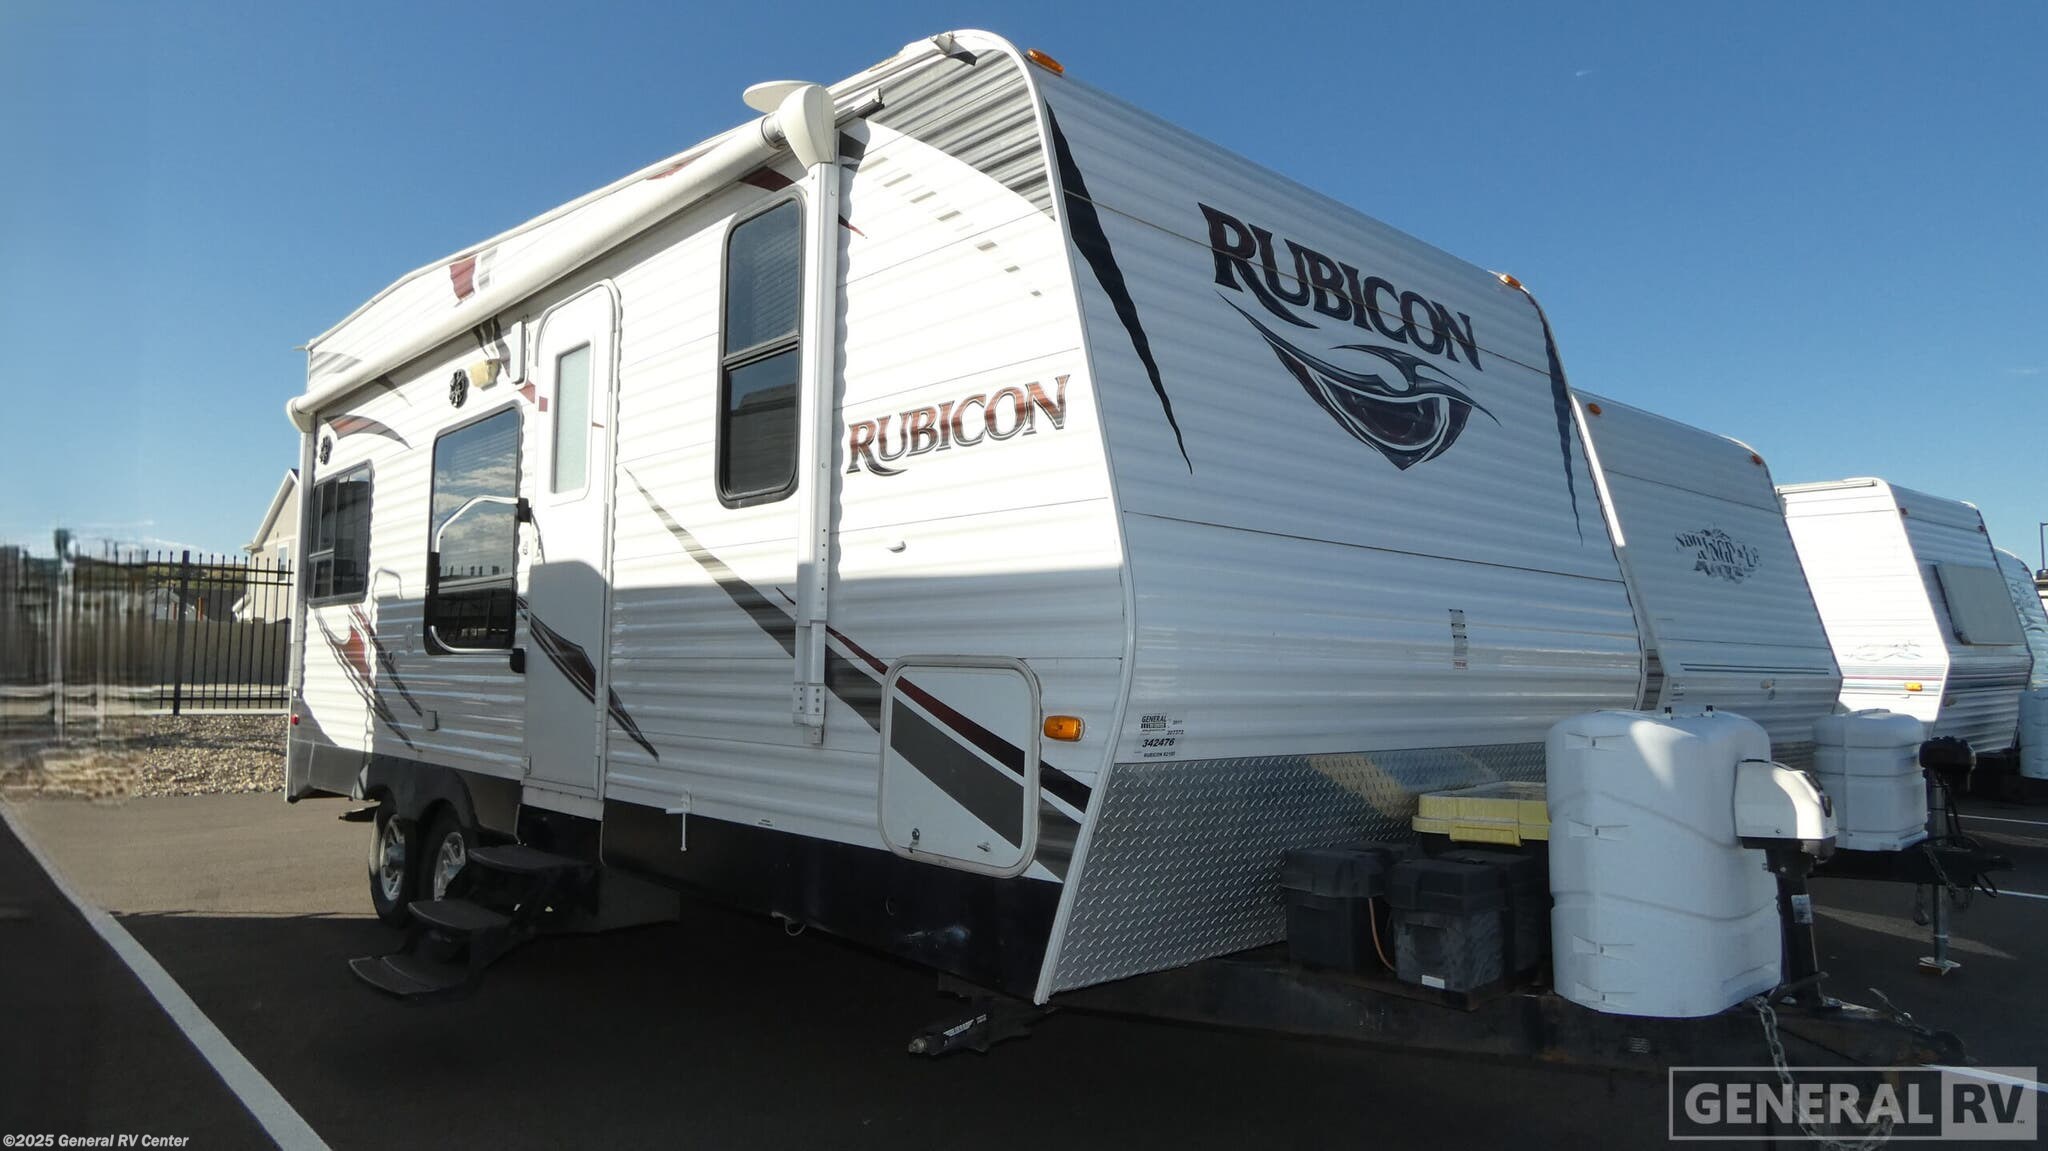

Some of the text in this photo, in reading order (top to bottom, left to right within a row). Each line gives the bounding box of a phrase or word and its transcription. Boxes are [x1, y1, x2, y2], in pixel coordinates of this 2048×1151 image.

[1197, 202, 1483, 371] RUBICON
[846, 374, 1070, 476] RUBICON
[1142, 738, 1175, 747] 342476
